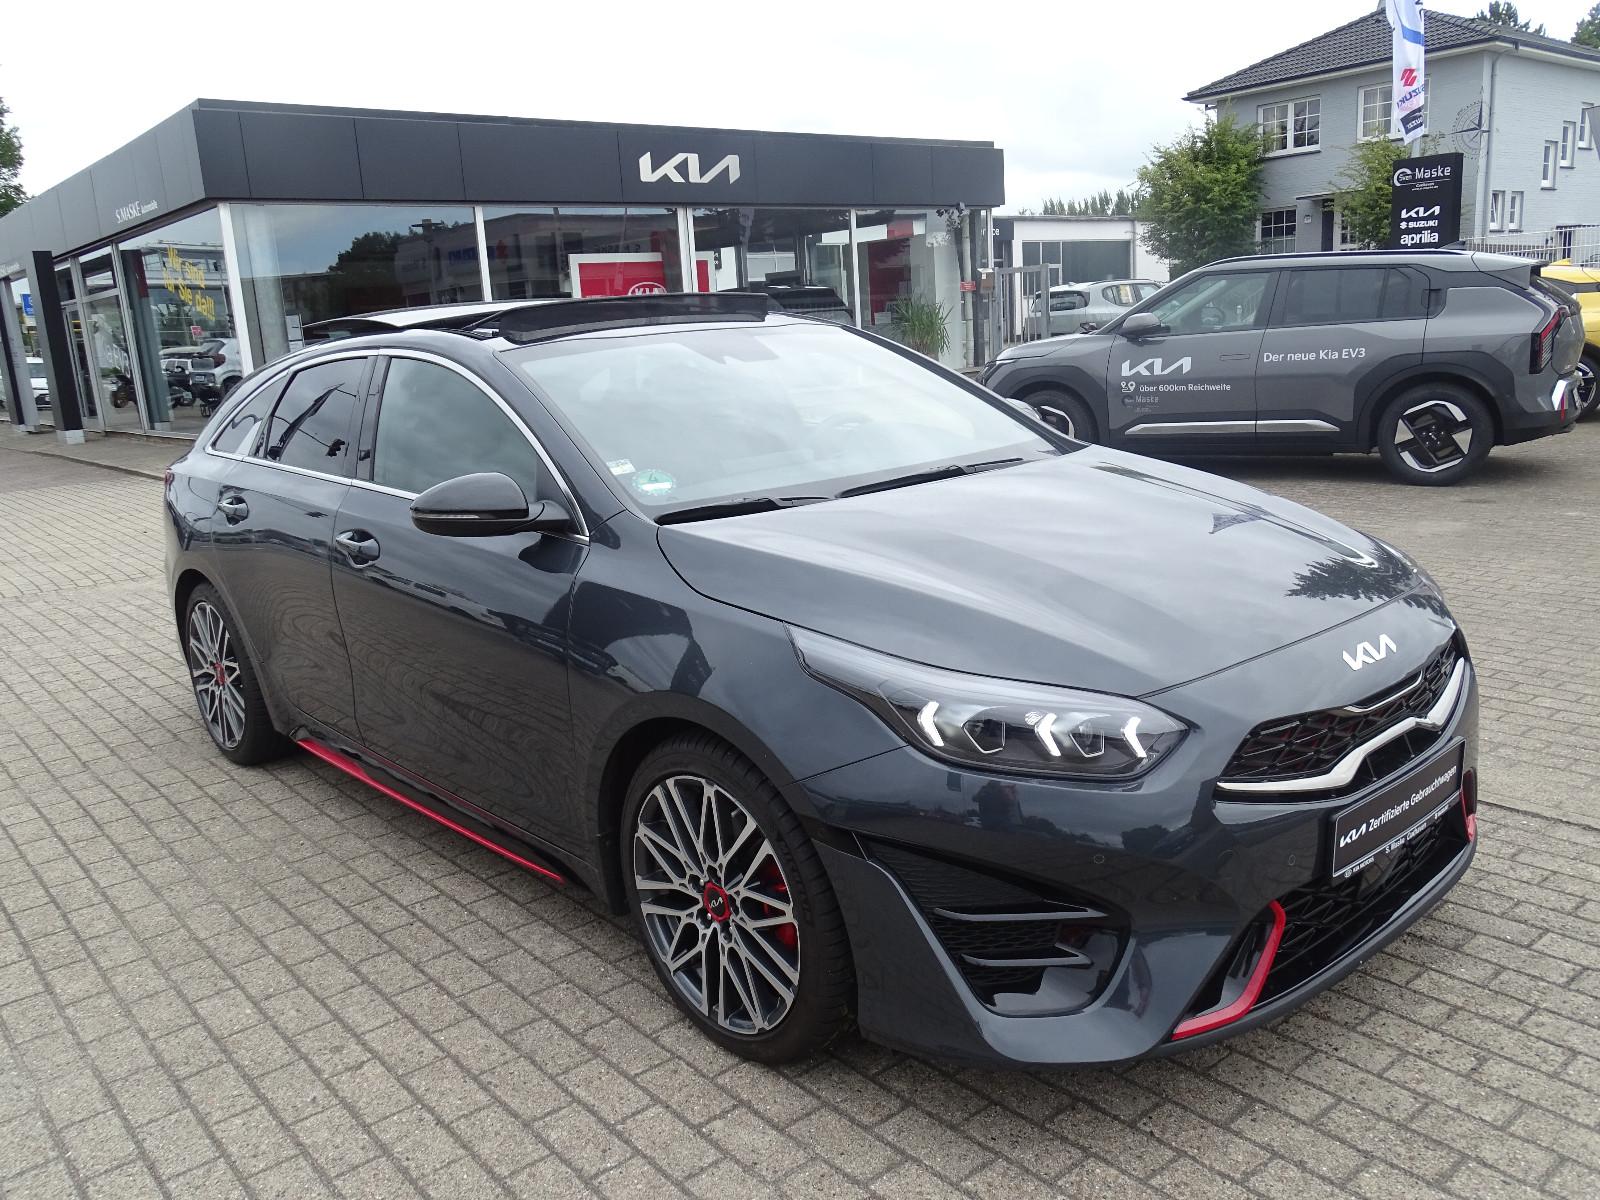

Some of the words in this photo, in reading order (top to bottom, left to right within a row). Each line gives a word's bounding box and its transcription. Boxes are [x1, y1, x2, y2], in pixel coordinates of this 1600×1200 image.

[639, 151, 740, 184] KIA
[1415, 165, 1451, 180] Maske
[1400, 205, 1441, 219] KIA
[1408, 219, 1438, 228] SUZUKI
[1400, 229, 1439, 246] aprilia
[178, 278, 193, 305] Sie
[1263, 352, 1284, 362] Der
[1287, 352, 1316, 361] neue
[1319, 349, 1339, 359] Kia
[1342, 347, 1366, 358] EV3
[1121, 356, 1192, 377] KIA
[1139, 383, 1157, 392] über
[1158, 384, 1186, 392] 600km
[1188, 383, 1231, 391] Reichweite
[1135, 395, 1159, 403] Maske
[1342, 633, 1397, 671] KIA
[1340, 823, 1366, 848] KIA
[1368, 799, 1410, 832] Zertifizierte
[1410, 765, 1457, 806] Gebrauchtwagen
